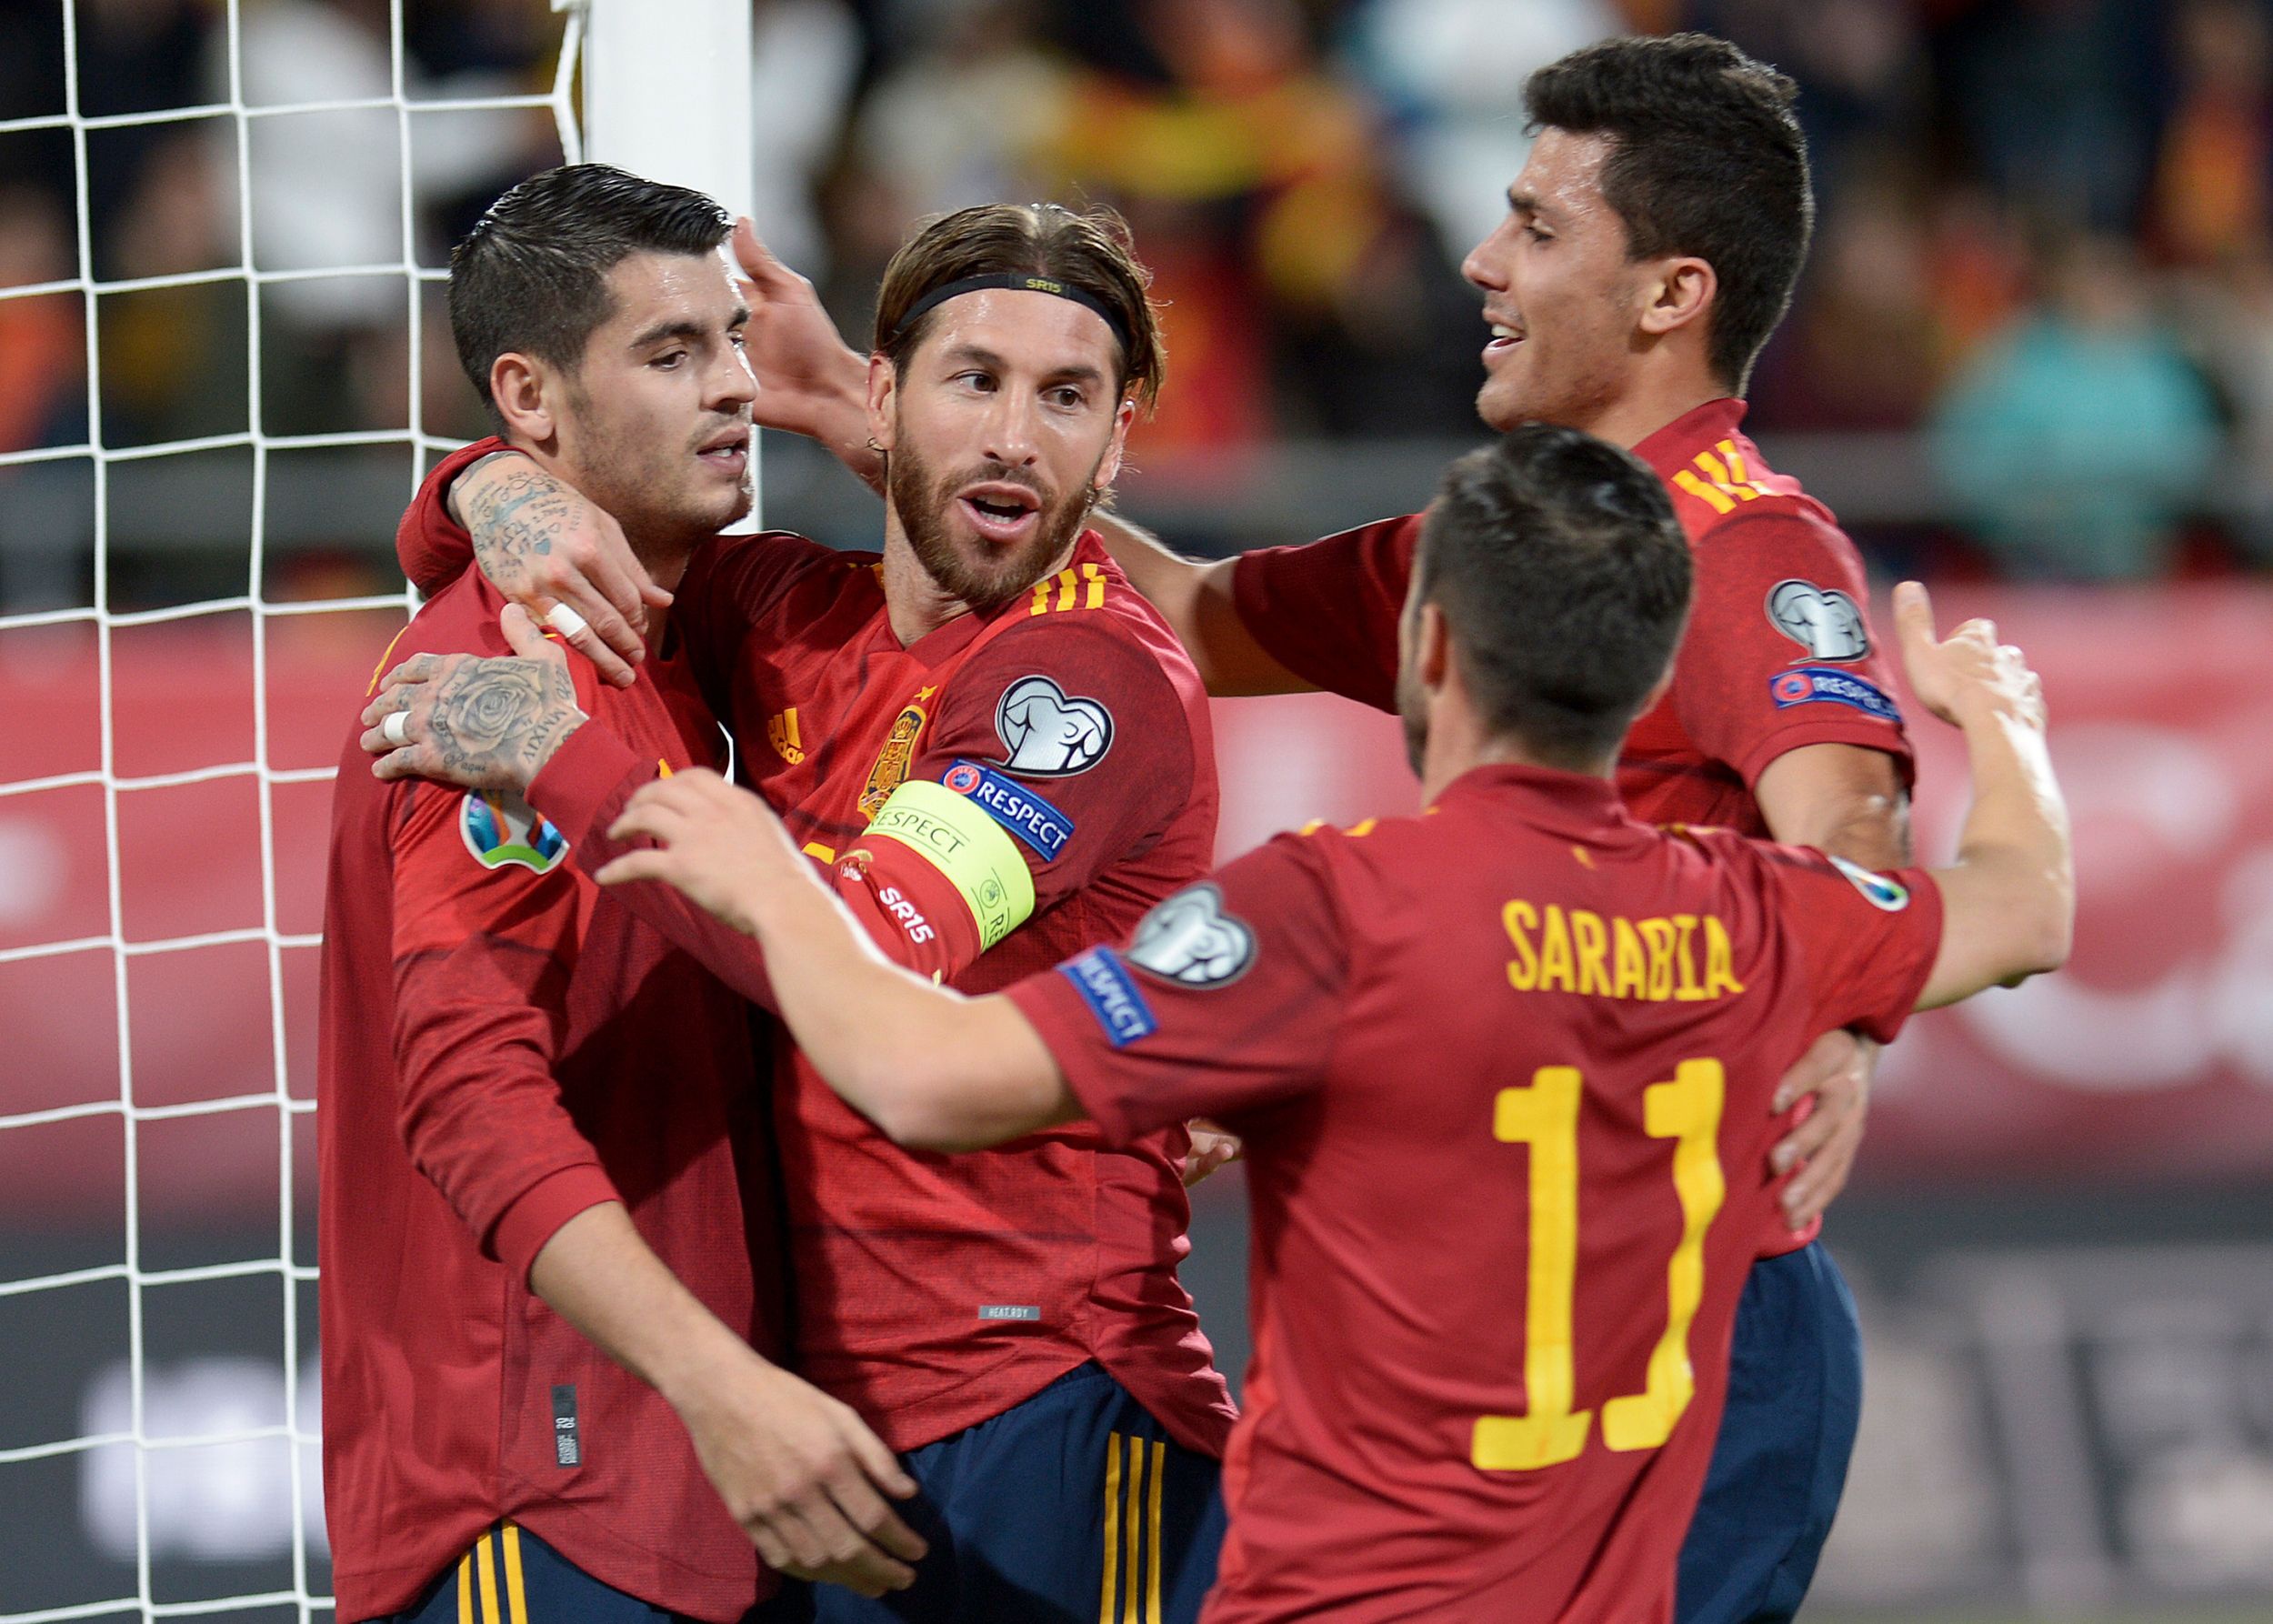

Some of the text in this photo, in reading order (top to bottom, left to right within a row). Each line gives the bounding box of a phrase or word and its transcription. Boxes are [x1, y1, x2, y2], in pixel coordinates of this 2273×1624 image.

[1026, 278, 1062, 294] SR15
[976, 781, 1067, 850] RESPECT
[879, 887, 935, 944] SR15
[1502, 899, 1747, 1001] SARABIA
[1471, 1058, 1726, 1470] 11
